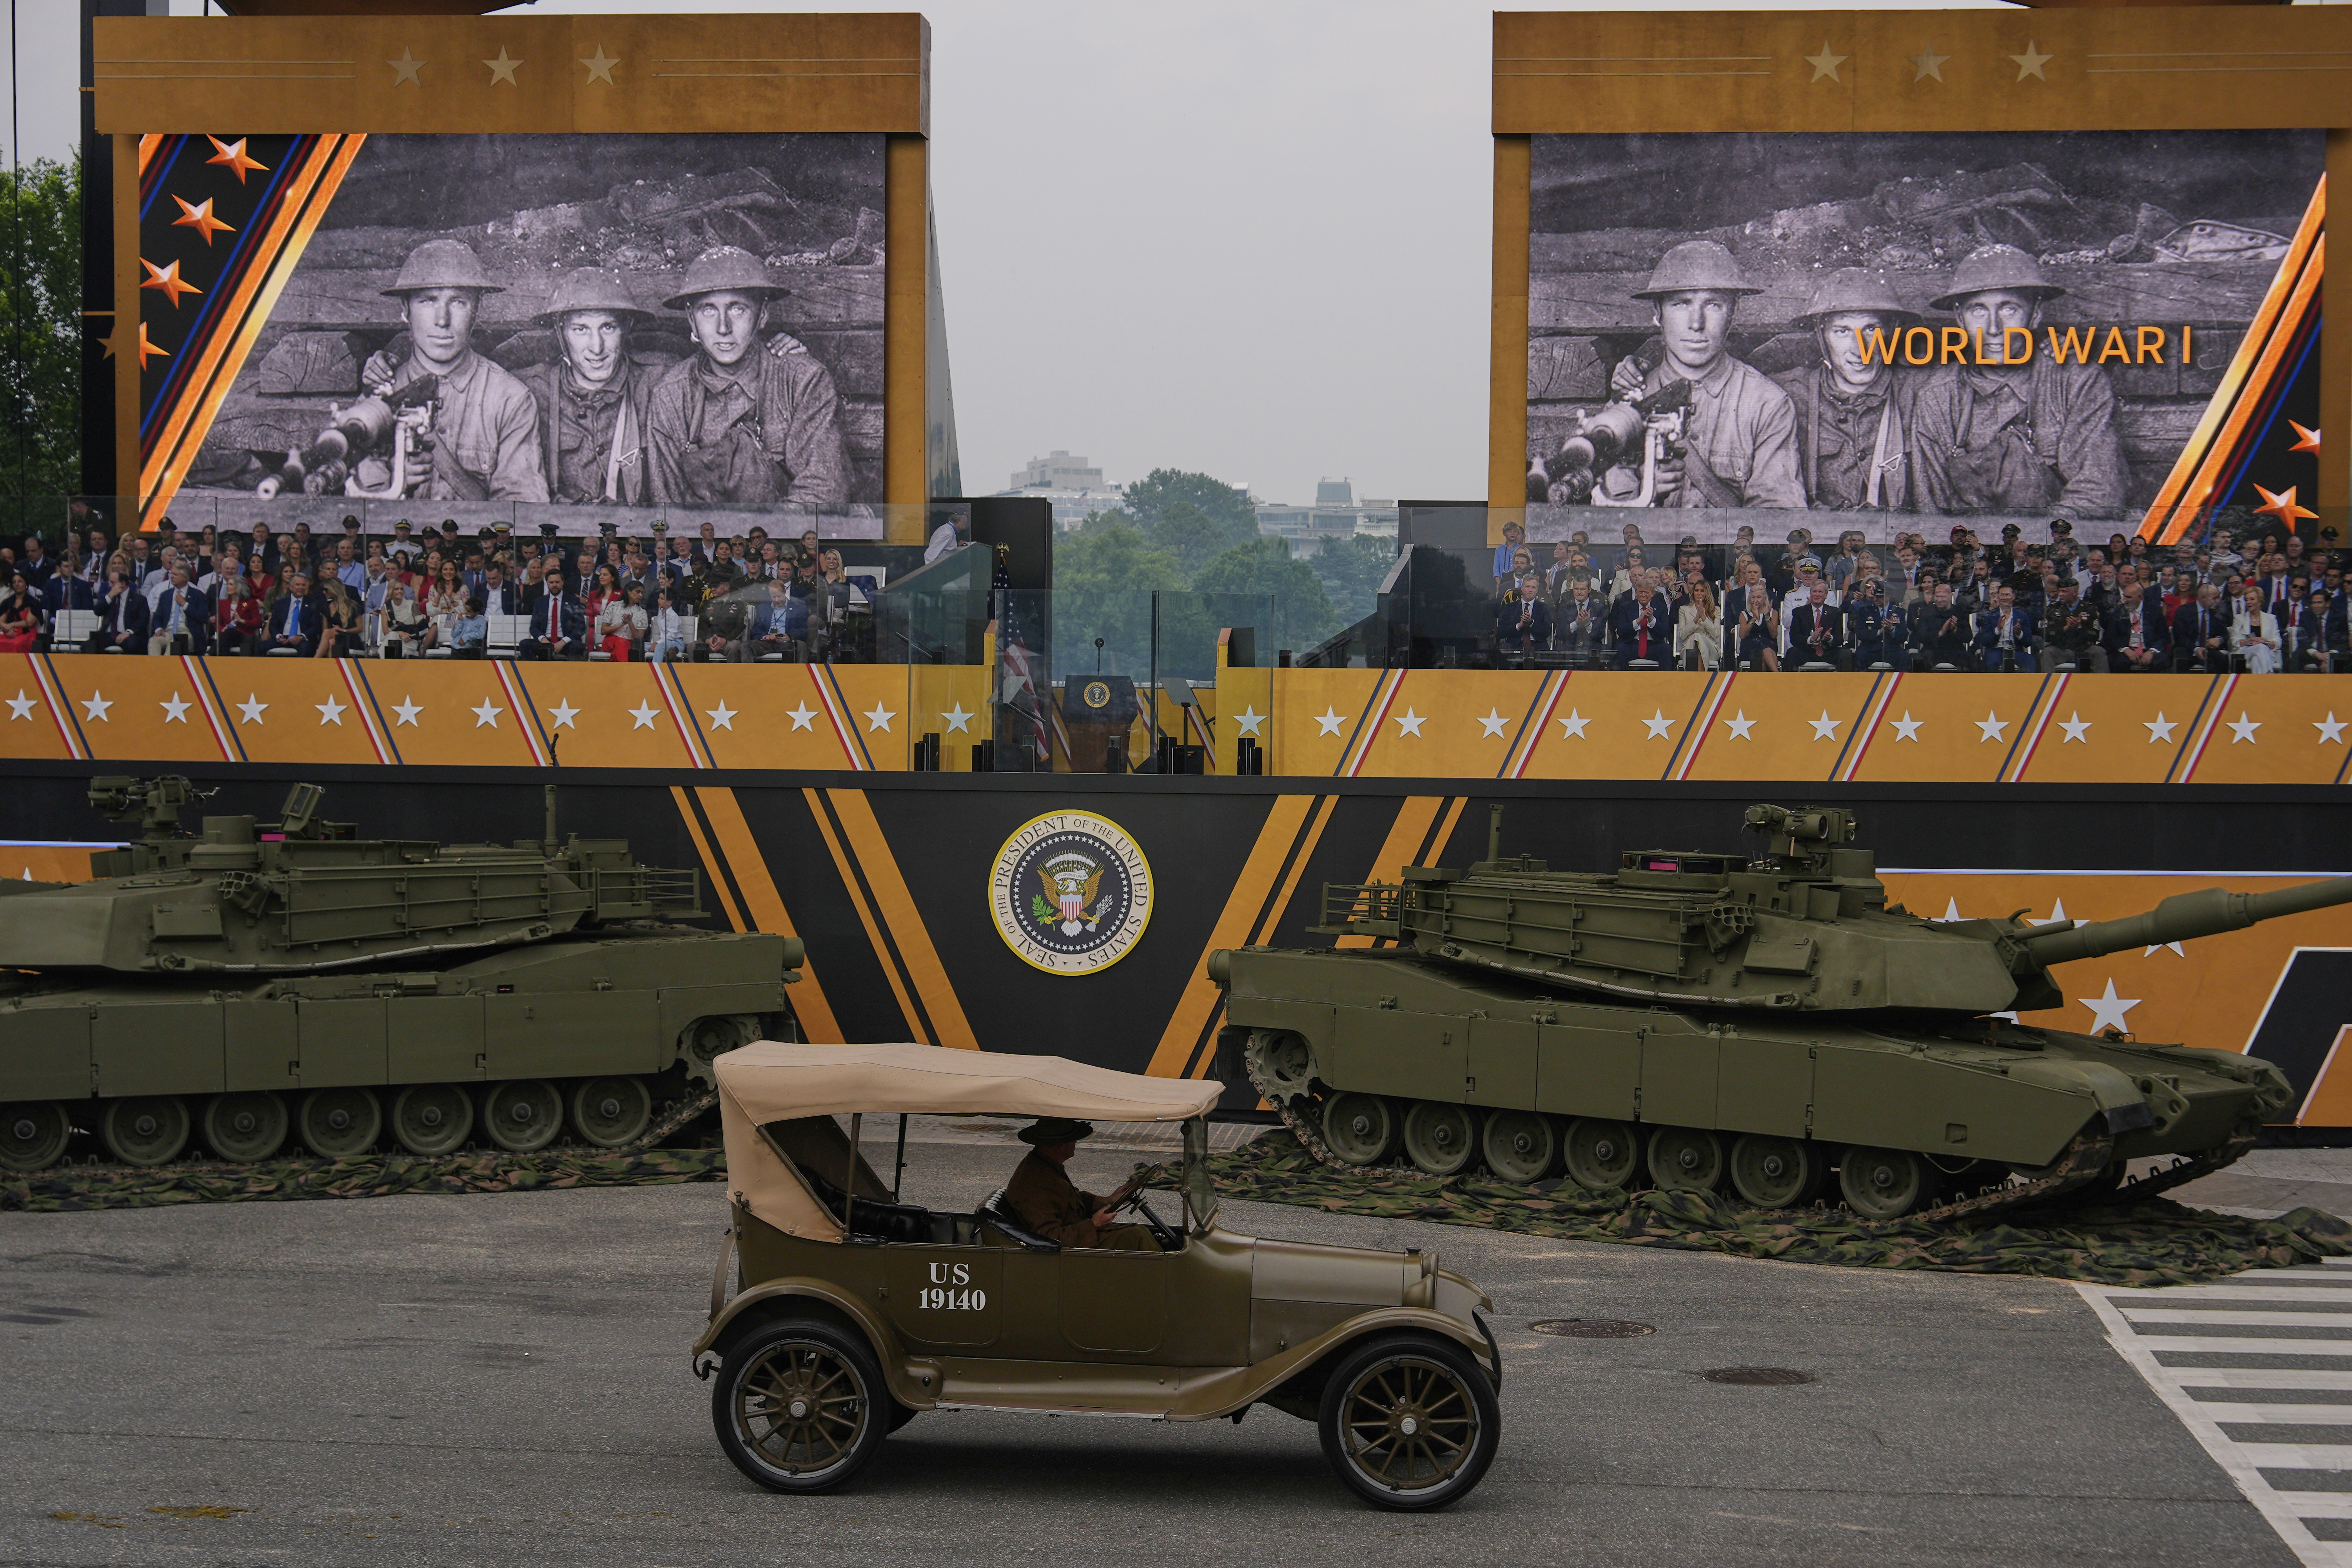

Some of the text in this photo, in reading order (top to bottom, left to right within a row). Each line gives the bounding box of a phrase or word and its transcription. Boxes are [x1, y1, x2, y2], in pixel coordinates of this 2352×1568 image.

[1854, 325, 2191, 365] WORLD WAR I
[995, 816, 1147, 967] SEAL OF THE PRESIDENT OF THE UNITED STATES
[928, 1262, 970, 1285] US
[918, 1287, 986, 1311] 19140
